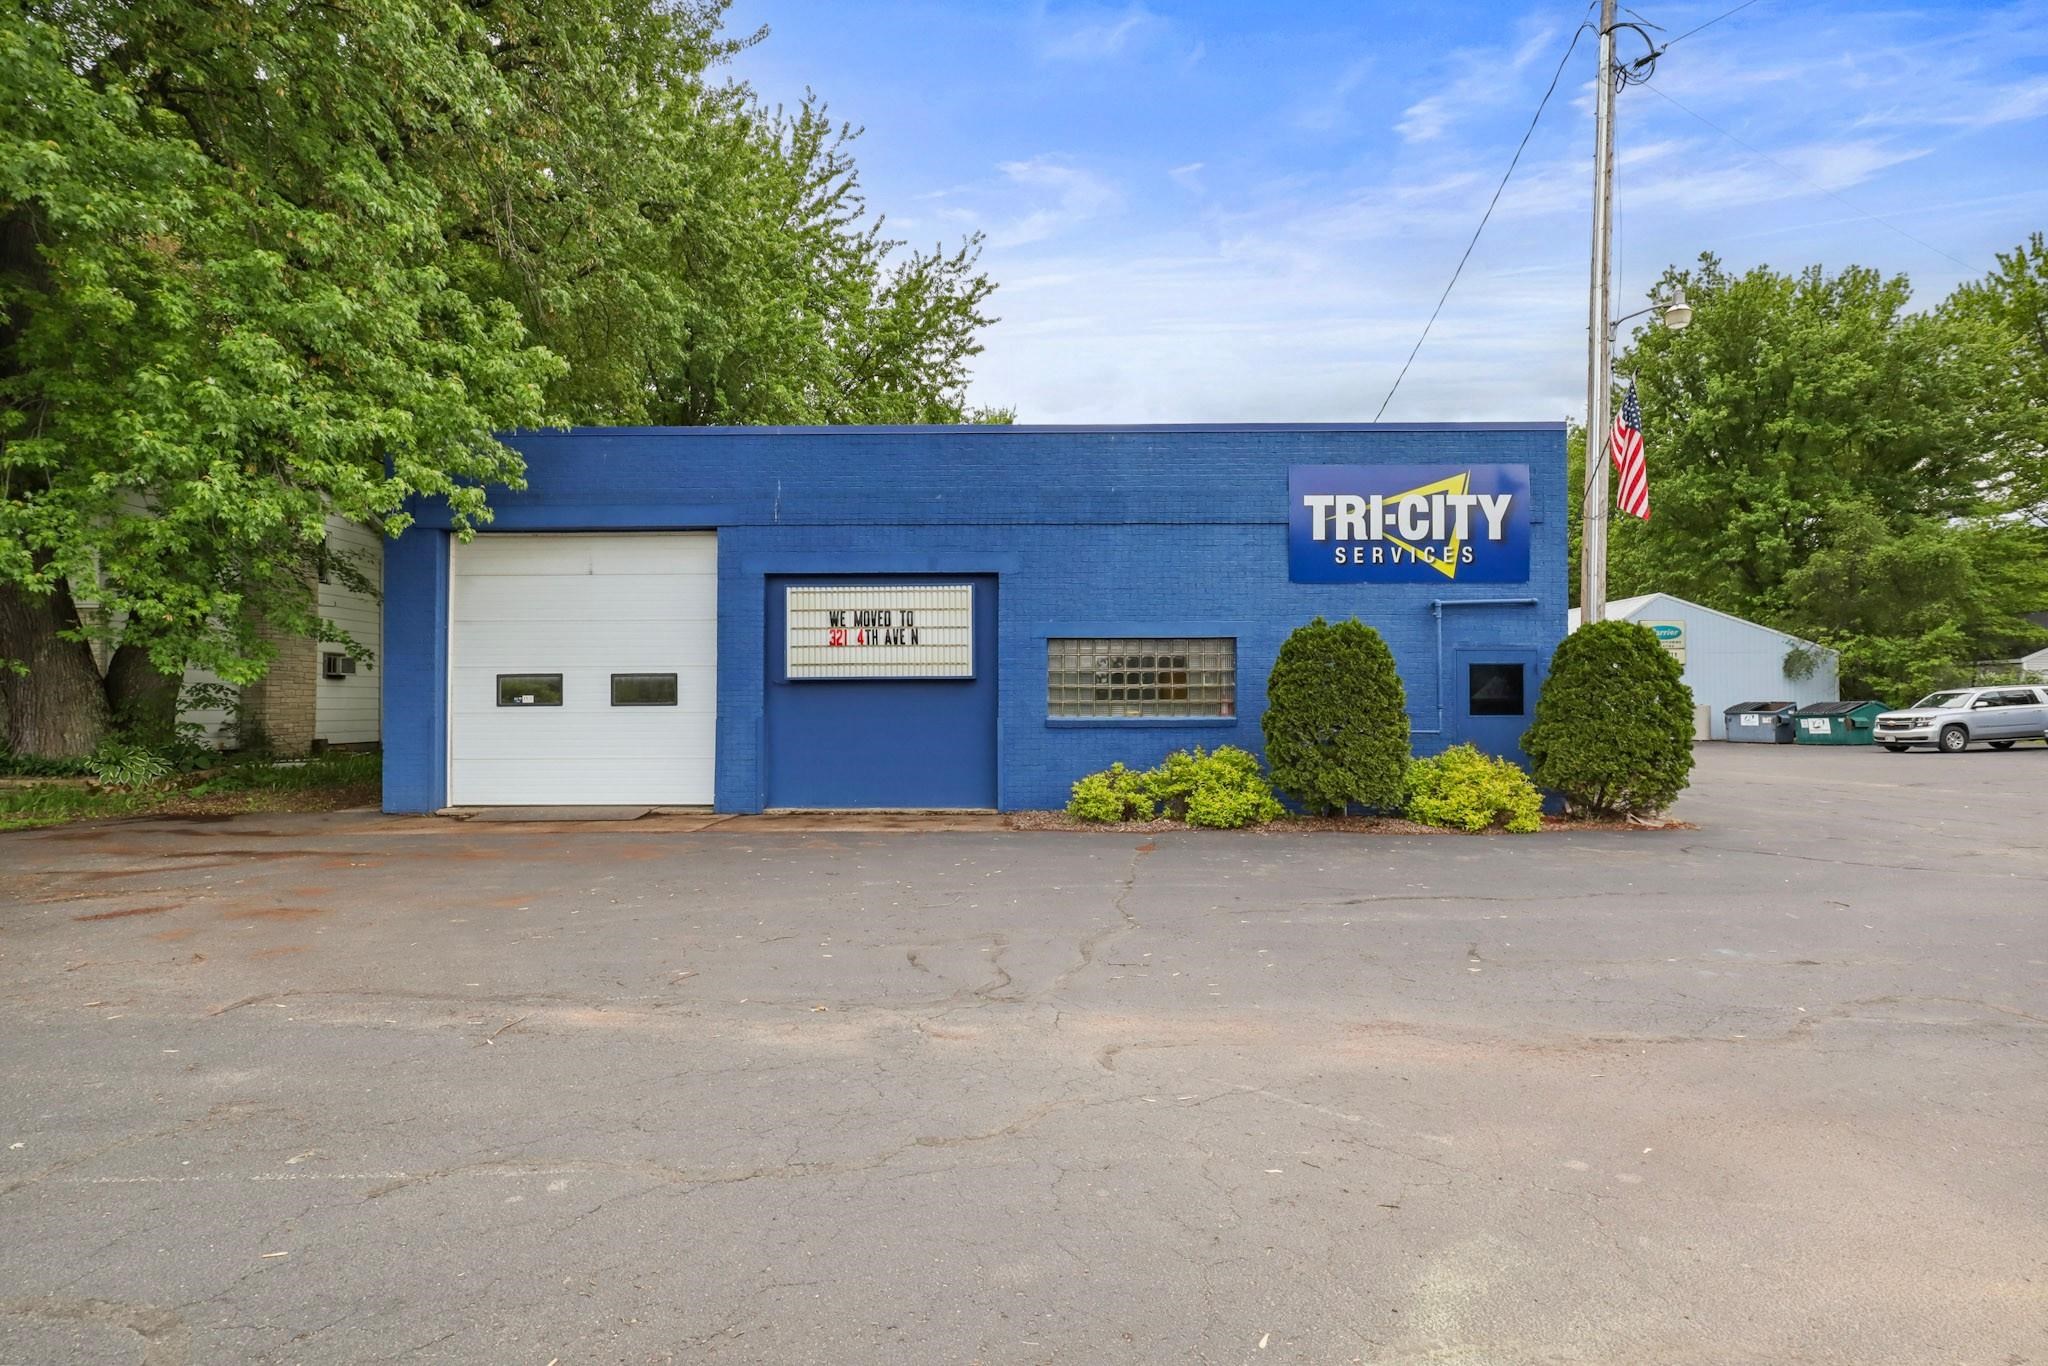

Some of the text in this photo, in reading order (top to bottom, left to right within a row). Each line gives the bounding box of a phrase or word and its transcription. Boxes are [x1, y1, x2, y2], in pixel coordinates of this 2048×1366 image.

[1303, 494, 1513, 541] TRI-CITY
[1335, 546, 1475, 564] SERVICES
[829, 610, 914, 627] WE MOVED TO
[829, 628, 919, 646] 321 4TH AVE N
